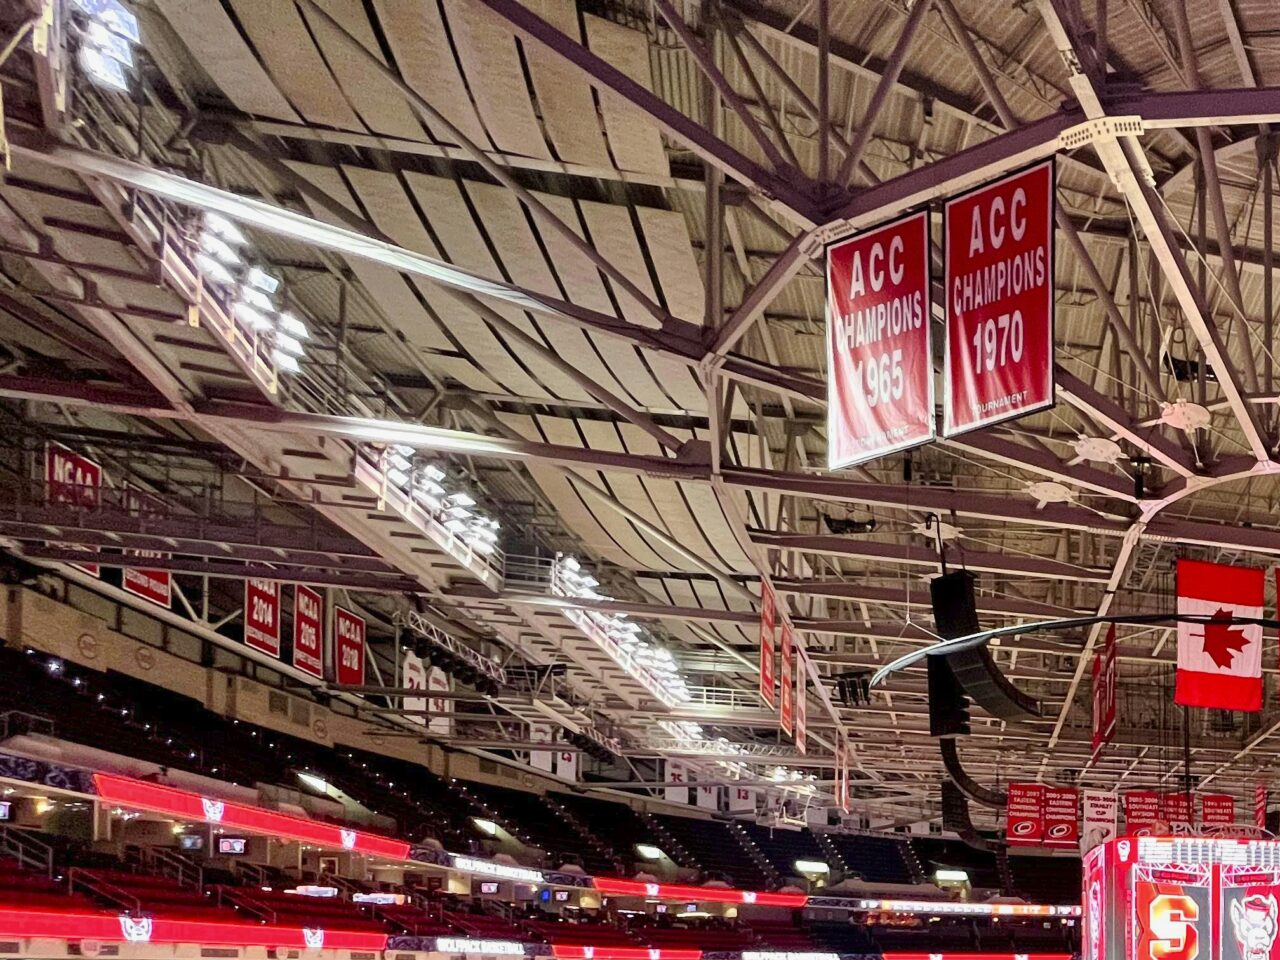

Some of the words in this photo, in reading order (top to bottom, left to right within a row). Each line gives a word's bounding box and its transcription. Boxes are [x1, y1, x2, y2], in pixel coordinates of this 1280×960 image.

[968, 187, 1027, 258] ACC
[850, 235, 904, 299] ACC
[953, 246, 1045, 316] CHAMPIONS
[836, 290, 922, 353] CHAMPIONS
[973, 310, 1024, 374] 1970
[853, 350, 903, 407] 1965
[971, 390, 1029, 416] TOURNAMENT
[54, 454, 94, 487] NCAA
[252, 596, 273, 627] 2014
[298, 592, 318, 622] NCAA
[339, 617, 362, 644] NCAA
